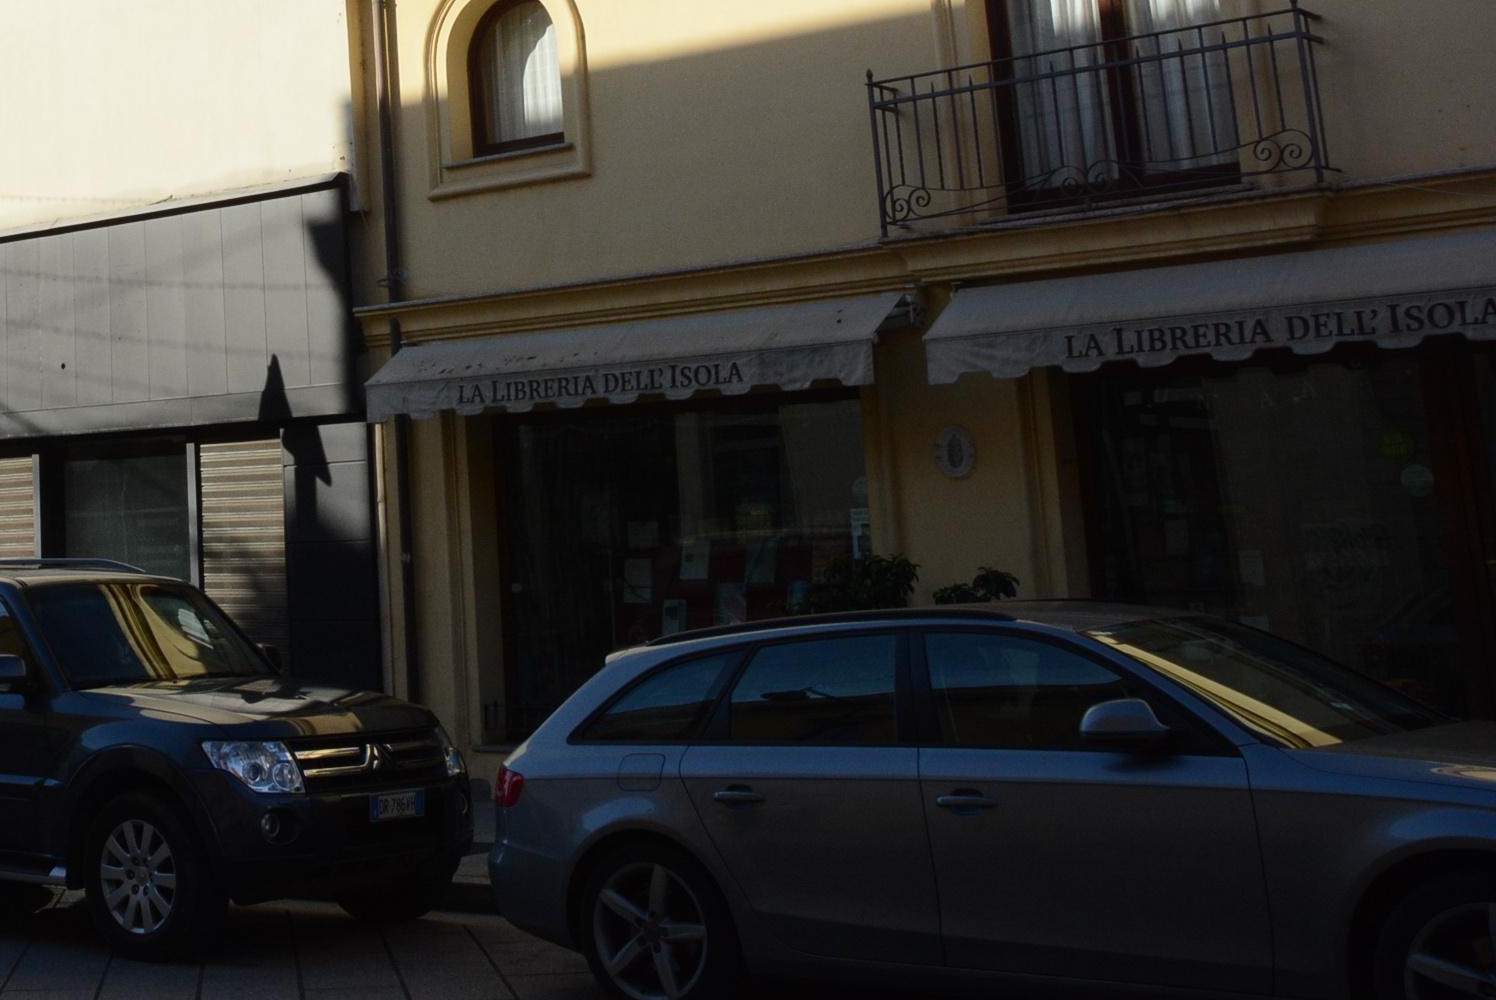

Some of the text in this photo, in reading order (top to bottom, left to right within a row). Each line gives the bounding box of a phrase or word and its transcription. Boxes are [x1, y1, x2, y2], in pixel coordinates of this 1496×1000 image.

[1065, 333, 1106, 359] LA
[1112, 318, 1273, 355] LIBRERIA
[458, 383, 485, 405] LA
[491, 375, 596, 403] LIBRERIA
